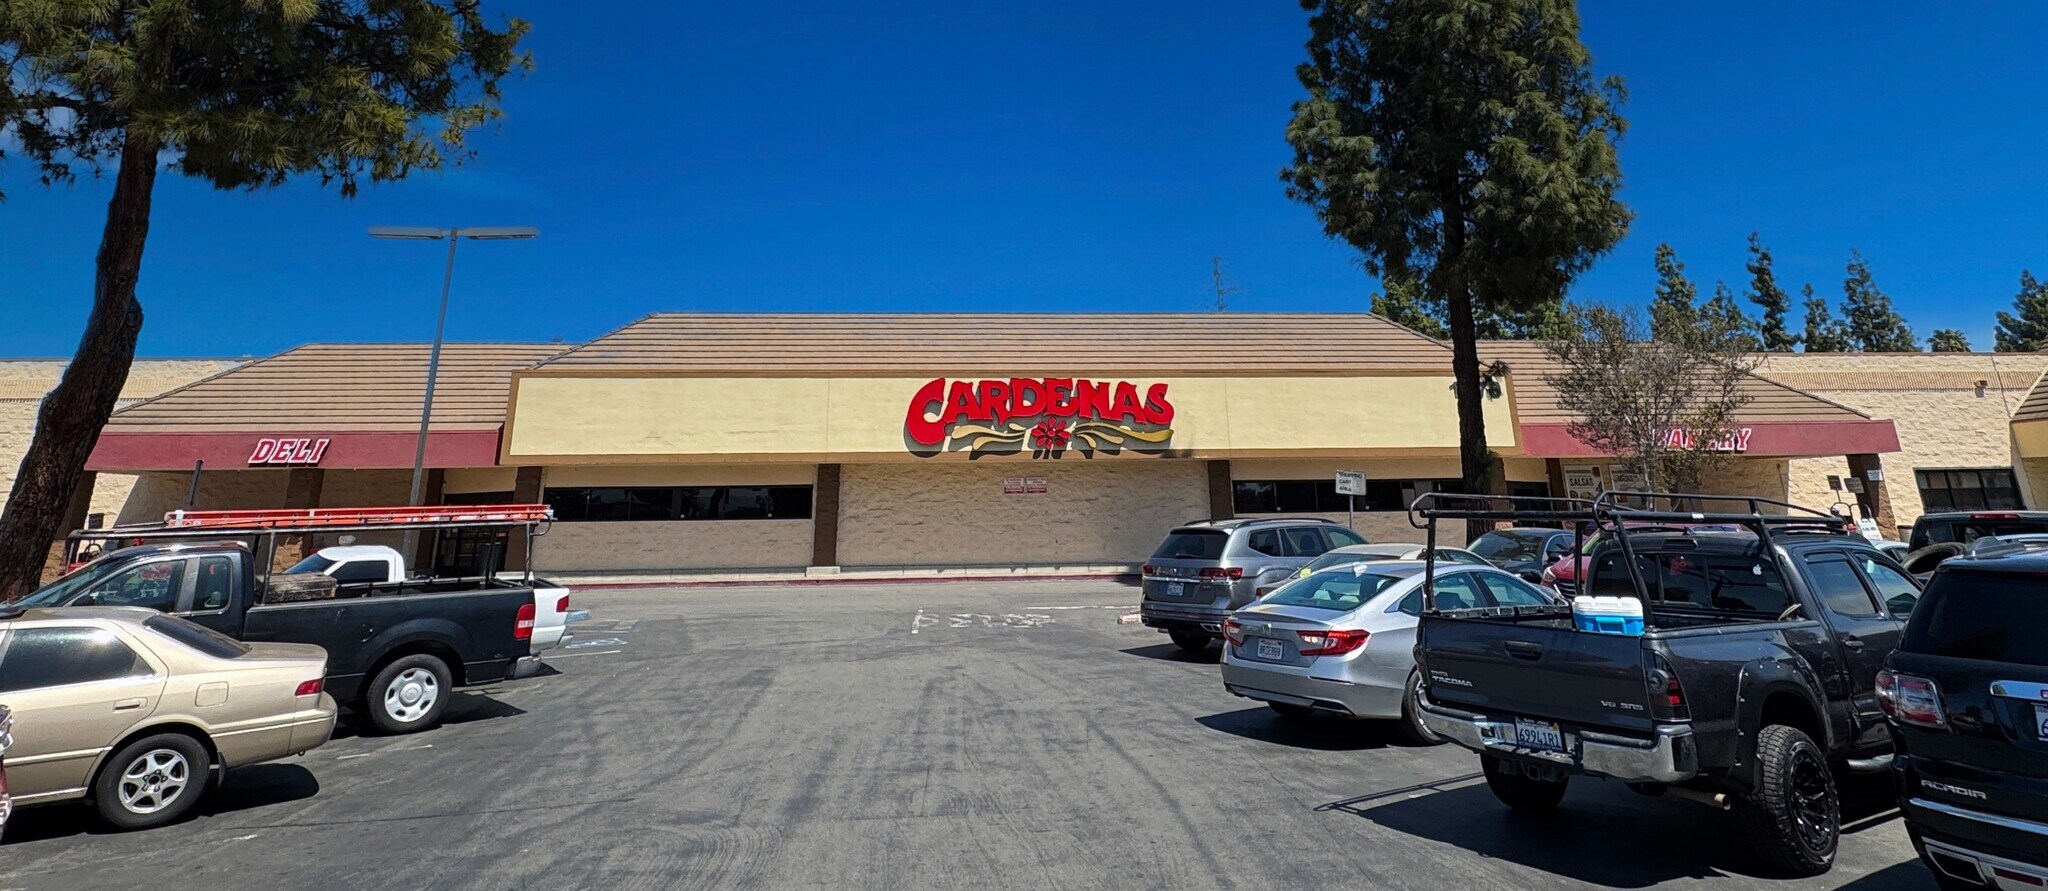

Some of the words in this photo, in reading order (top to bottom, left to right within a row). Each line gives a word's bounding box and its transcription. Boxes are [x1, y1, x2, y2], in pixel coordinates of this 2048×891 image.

[906, 378, 1175, 445] CARDENAS
[1652, 428, 1752, 451] AKRY
[247, 438, 330, 464] DELI
[1569, 477, 1594, 487] SALSAS
[1432, 676, 1474, 688] TACOMA
[1519, 728, 1561, 748] 69941R1
[1921, 779, 1987, 800] ACADIA
